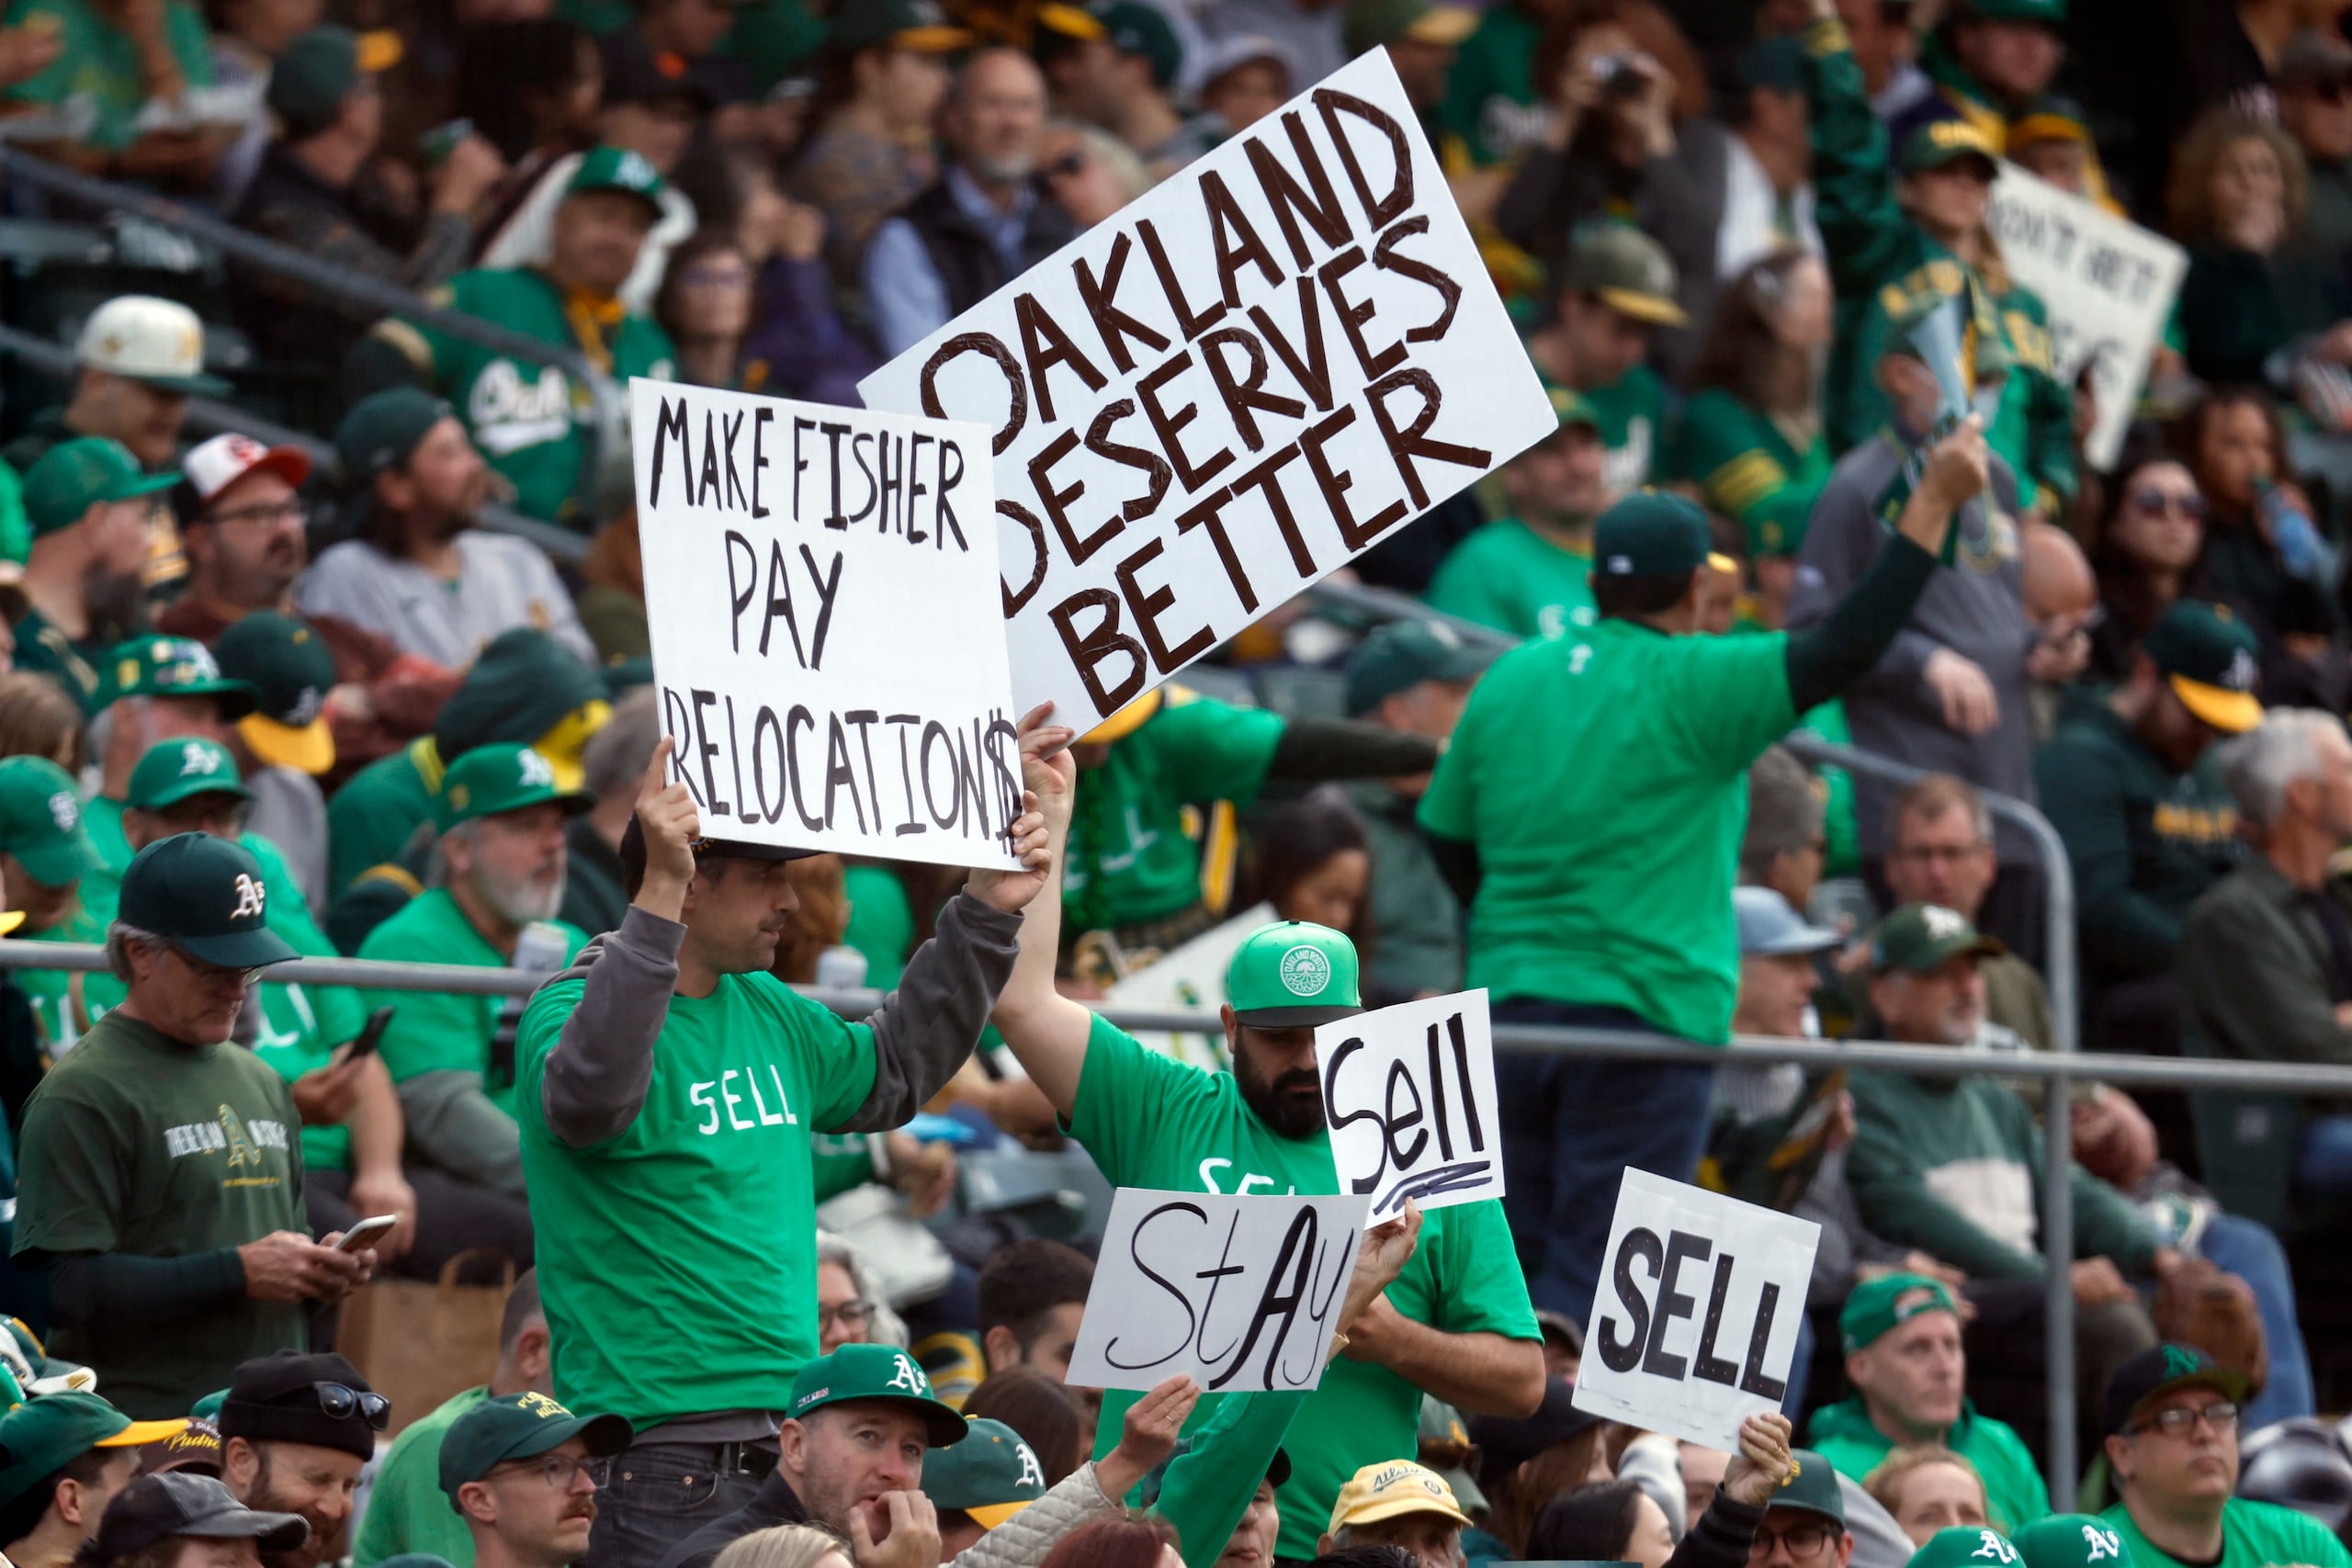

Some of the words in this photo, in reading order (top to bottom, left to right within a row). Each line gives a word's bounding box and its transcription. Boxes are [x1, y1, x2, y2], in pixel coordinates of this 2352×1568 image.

[920, 87, 1415, 457] OAKLAND
[650, 395, 775, 520] MAKE
[793, 415, 969, 552] FISHER
[995, 214, 1463, 619] DESERVES
[725, 529, 843, 671] PAY
[1047, 367, 1493, 719] BETTER
[1284, 950, 1309, 972] OAKLAND
[1309, 951, 1326, 972] ROOTS
[689, 1064, 798, 1135] SELL
[1323, 1011, 1485, 1194] Sell
[885, 1353, 927, 1395] A's
[1597, 1226, 1787, 1402] SELL
